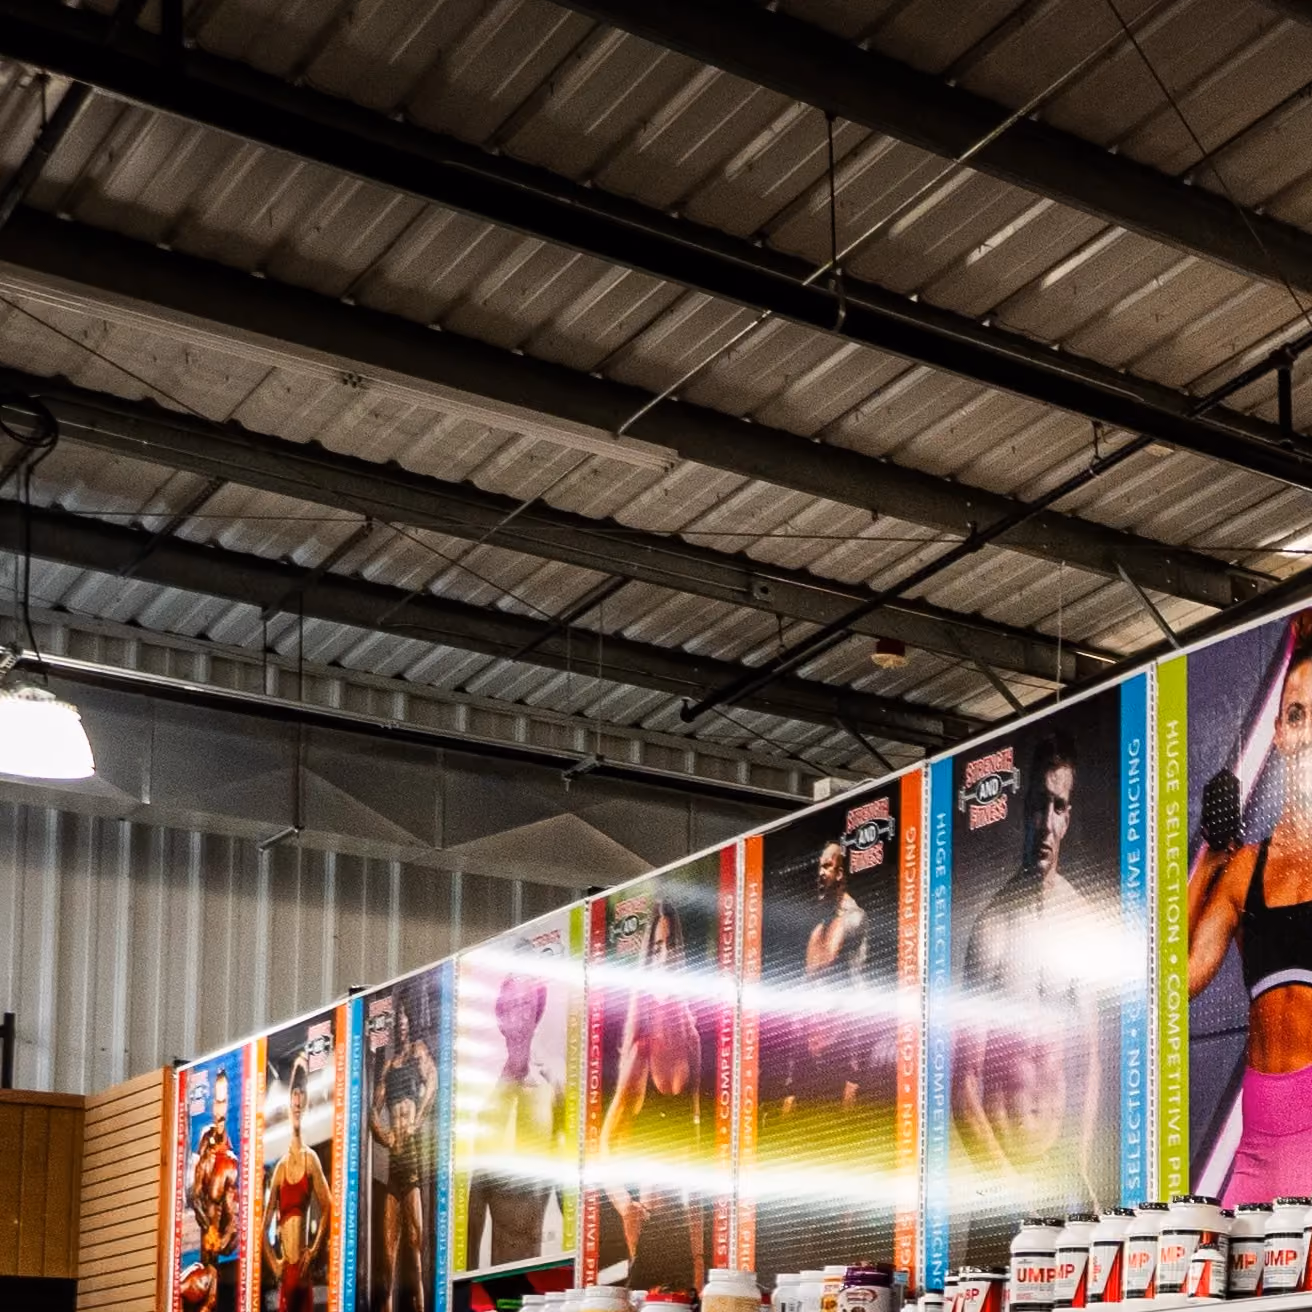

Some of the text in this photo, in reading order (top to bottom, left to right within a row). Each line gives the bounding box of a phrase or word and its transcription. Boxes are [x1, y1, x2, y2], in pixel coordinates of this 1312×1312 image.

[965, 747, 1014, 789] STRENGTH
[979, 776, 1002, 801] AND
[1128, 738, 1140, 841] PRICING
[936, 813, 946, 877] HUGE
[969, 800, 1008, 831] FITNESS
[748, 883, 757, 941] HUGE
[904, 825, 916, 918] PRICING
[1167, 720, 1181, 1146] HUGE SELECTION COMPETITIVE
[350, 1085, 359, 1172] SELECTION
[1128, 1048, 1141, 1188] SELECTION
[346, 1191, 355, 1296] COMPETITIVE
